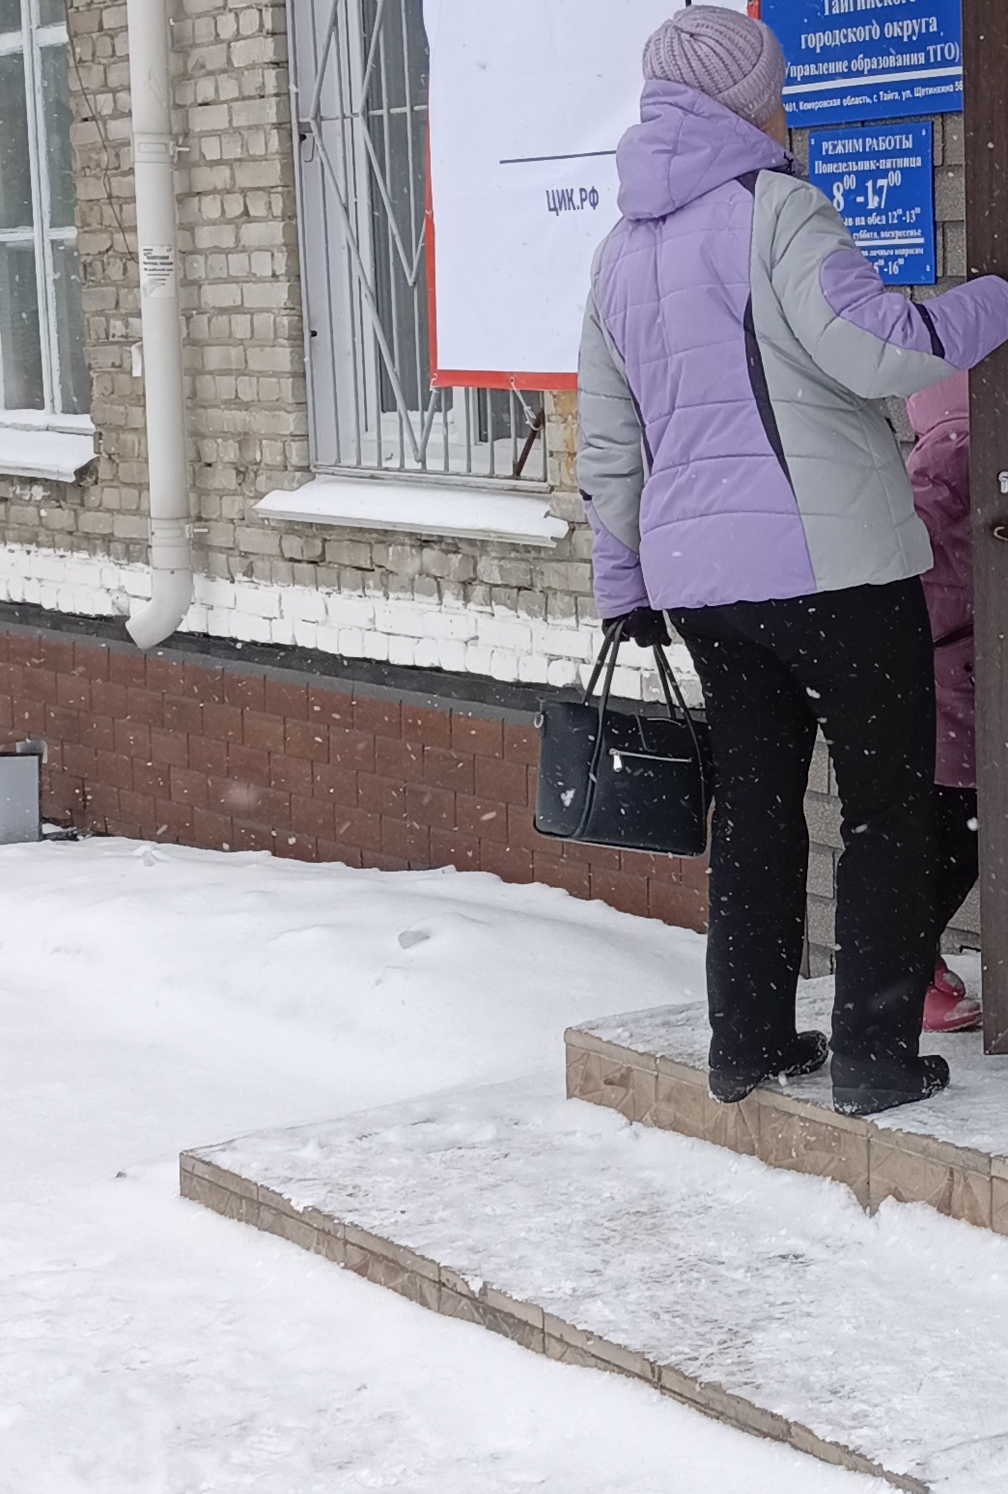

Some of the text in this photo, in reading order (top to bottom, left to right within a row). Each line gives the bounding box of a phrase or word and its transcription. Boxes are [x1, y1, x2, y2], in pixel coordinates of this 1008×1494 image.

[800, 15, 938, 53] городского округа
[850, 51, 925, 75] образования
[926, 41, 960, 63] ТГО)
[821, 134, 913, 156] РЕЖИМ РАБОТЫ
[814, 156, 922, 175] Понедельник-пятница
[545, 185, 600, 217] ЦИК.РФ
